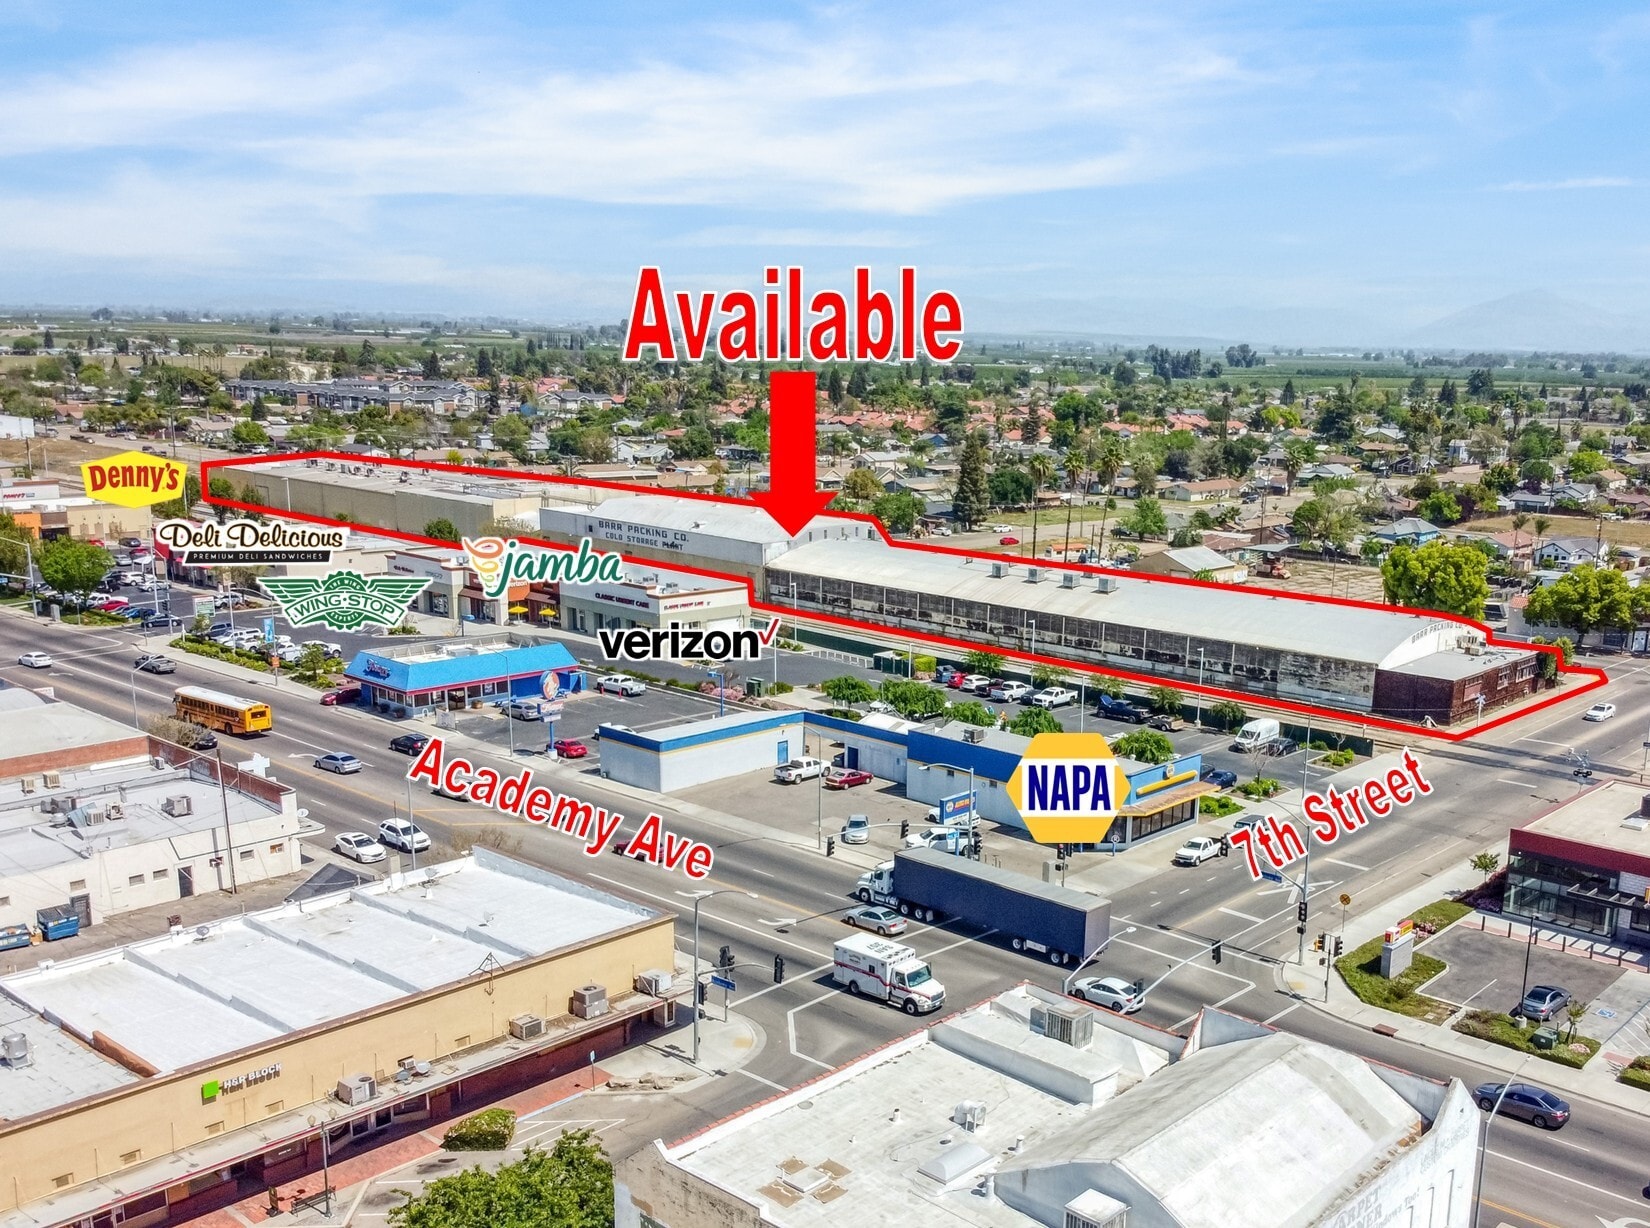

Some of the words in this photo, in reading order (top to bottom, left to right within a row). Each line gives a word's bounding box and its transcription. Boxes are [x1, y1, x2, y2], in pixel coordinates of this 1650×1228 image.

[598, 520, 623, 532] BARR
[627, 525, 668, 539] PACKING
[674, 532, 689, 542] CO.
[605, 532, 623, 541] COLD
[627, 535, 658, 547] STORAGE
[224, 1075, 246, 1088] H&R
[248, 1063, 282, 1081] BLOCK
